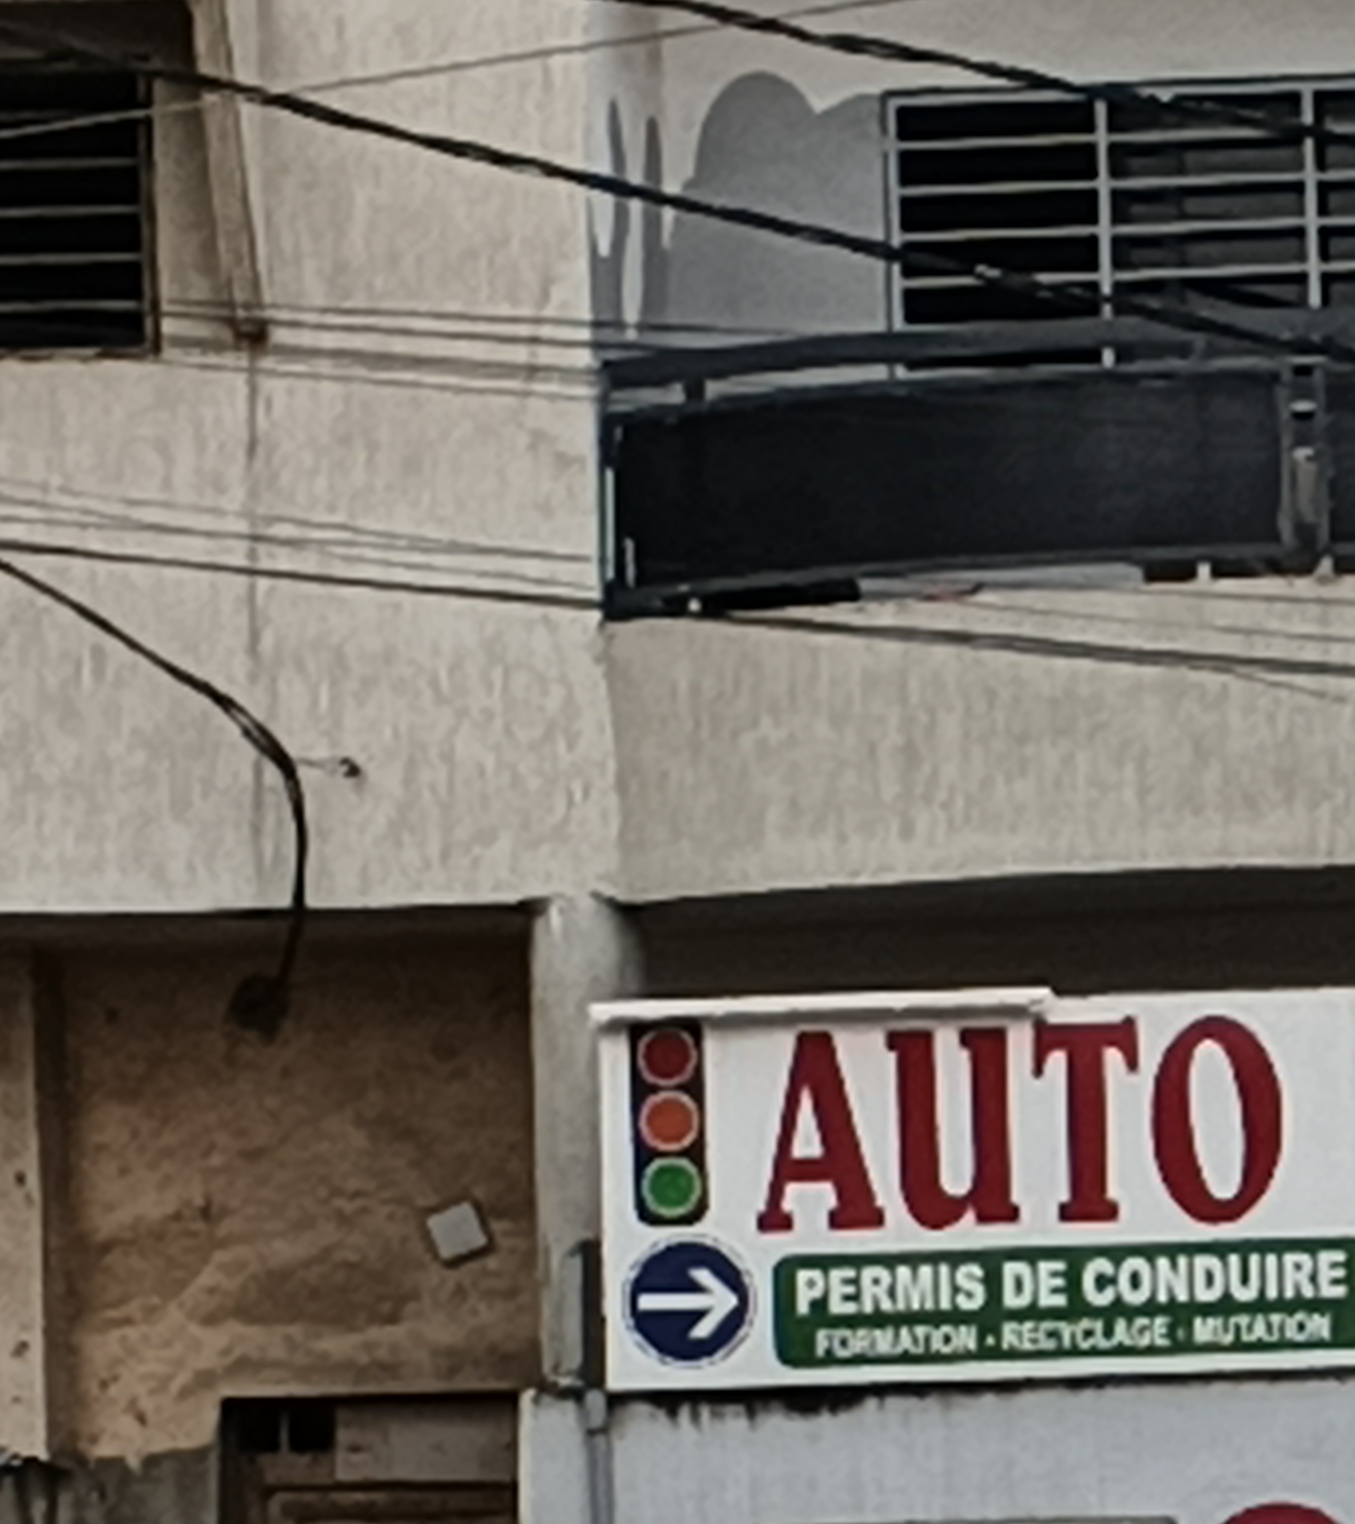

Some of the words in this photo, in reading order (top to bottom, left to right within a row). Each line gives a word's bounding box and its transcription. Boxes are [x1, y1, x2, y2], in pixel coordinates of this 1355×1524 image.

[757, 1016, 1283, 1232] AUTO
[795, 1264, 986, 1315] PERMIS
[1002, 1260, 1067, 1309] DE
[1081, 1250, 1348, 1307] CONDUIRE
[816, 1323, 976, 1357] FORMATION
[1002, 1316, 1169, 1350] RECYCLAGE
[1193, 1311, 1330, 1342] MUTATION
